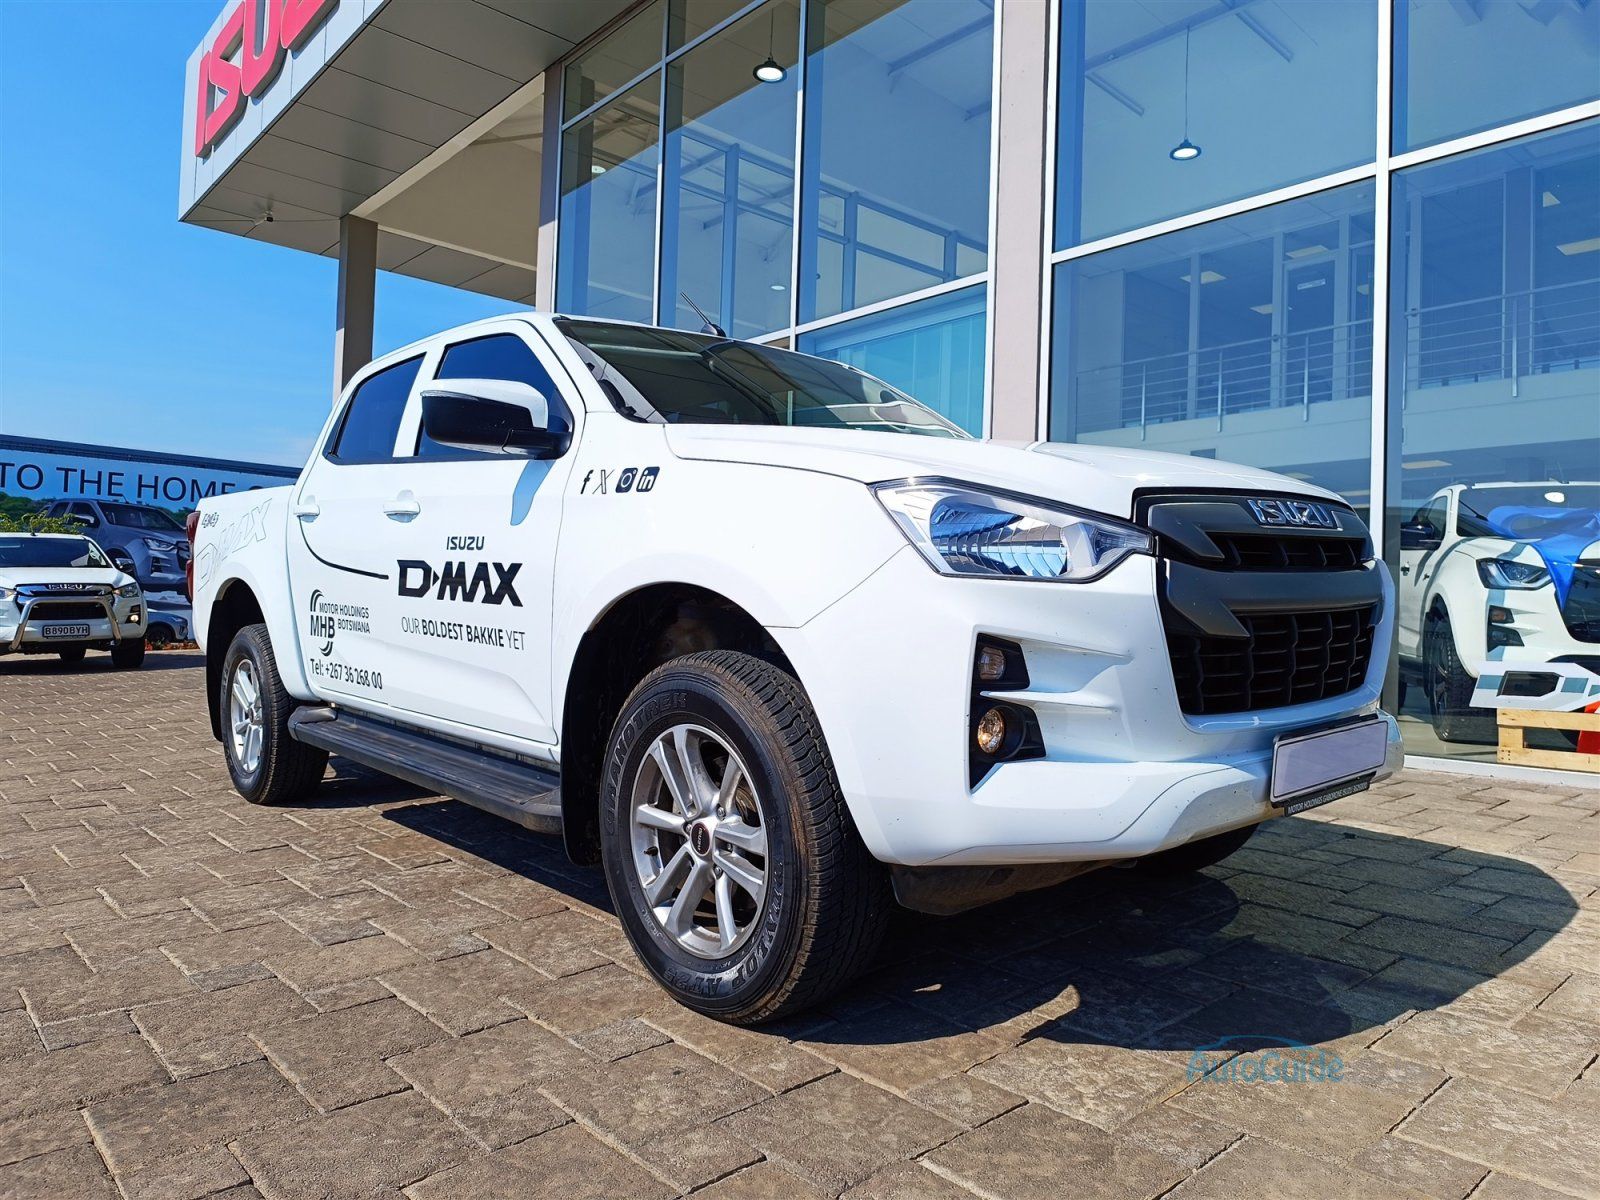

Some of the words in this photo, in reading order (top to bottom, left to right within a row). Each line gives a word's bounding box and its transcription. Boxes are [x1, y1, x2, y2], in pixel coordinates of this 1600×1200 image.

[0, 462, 44, 490] TO
[56, 467, 125, 497] THE
[1247, 499, 1334, 527] ISUZU
[446, 536, 485, 550] ISUZU
[319, 603, 338, 614] MOTOR
[339, 605, 370, 619] HOLDINGS
[310, 615, 335, 638] MHB
[337, 618, 371, 633] BOTSWANA
[401, 616, 421, 634] OUR
[421, 619, 463, 641] BOLDEST
[466, 624, 505, 647] BAKKIE
[505, 629, 526, 650] YET
[310, 658, 324, 676] Tel:
[326, 662, 343, 680] +267
[344, 665, 354, 683] 36
[355, 668, 371, 687] 268
[371, 672, 383, 689] 00
